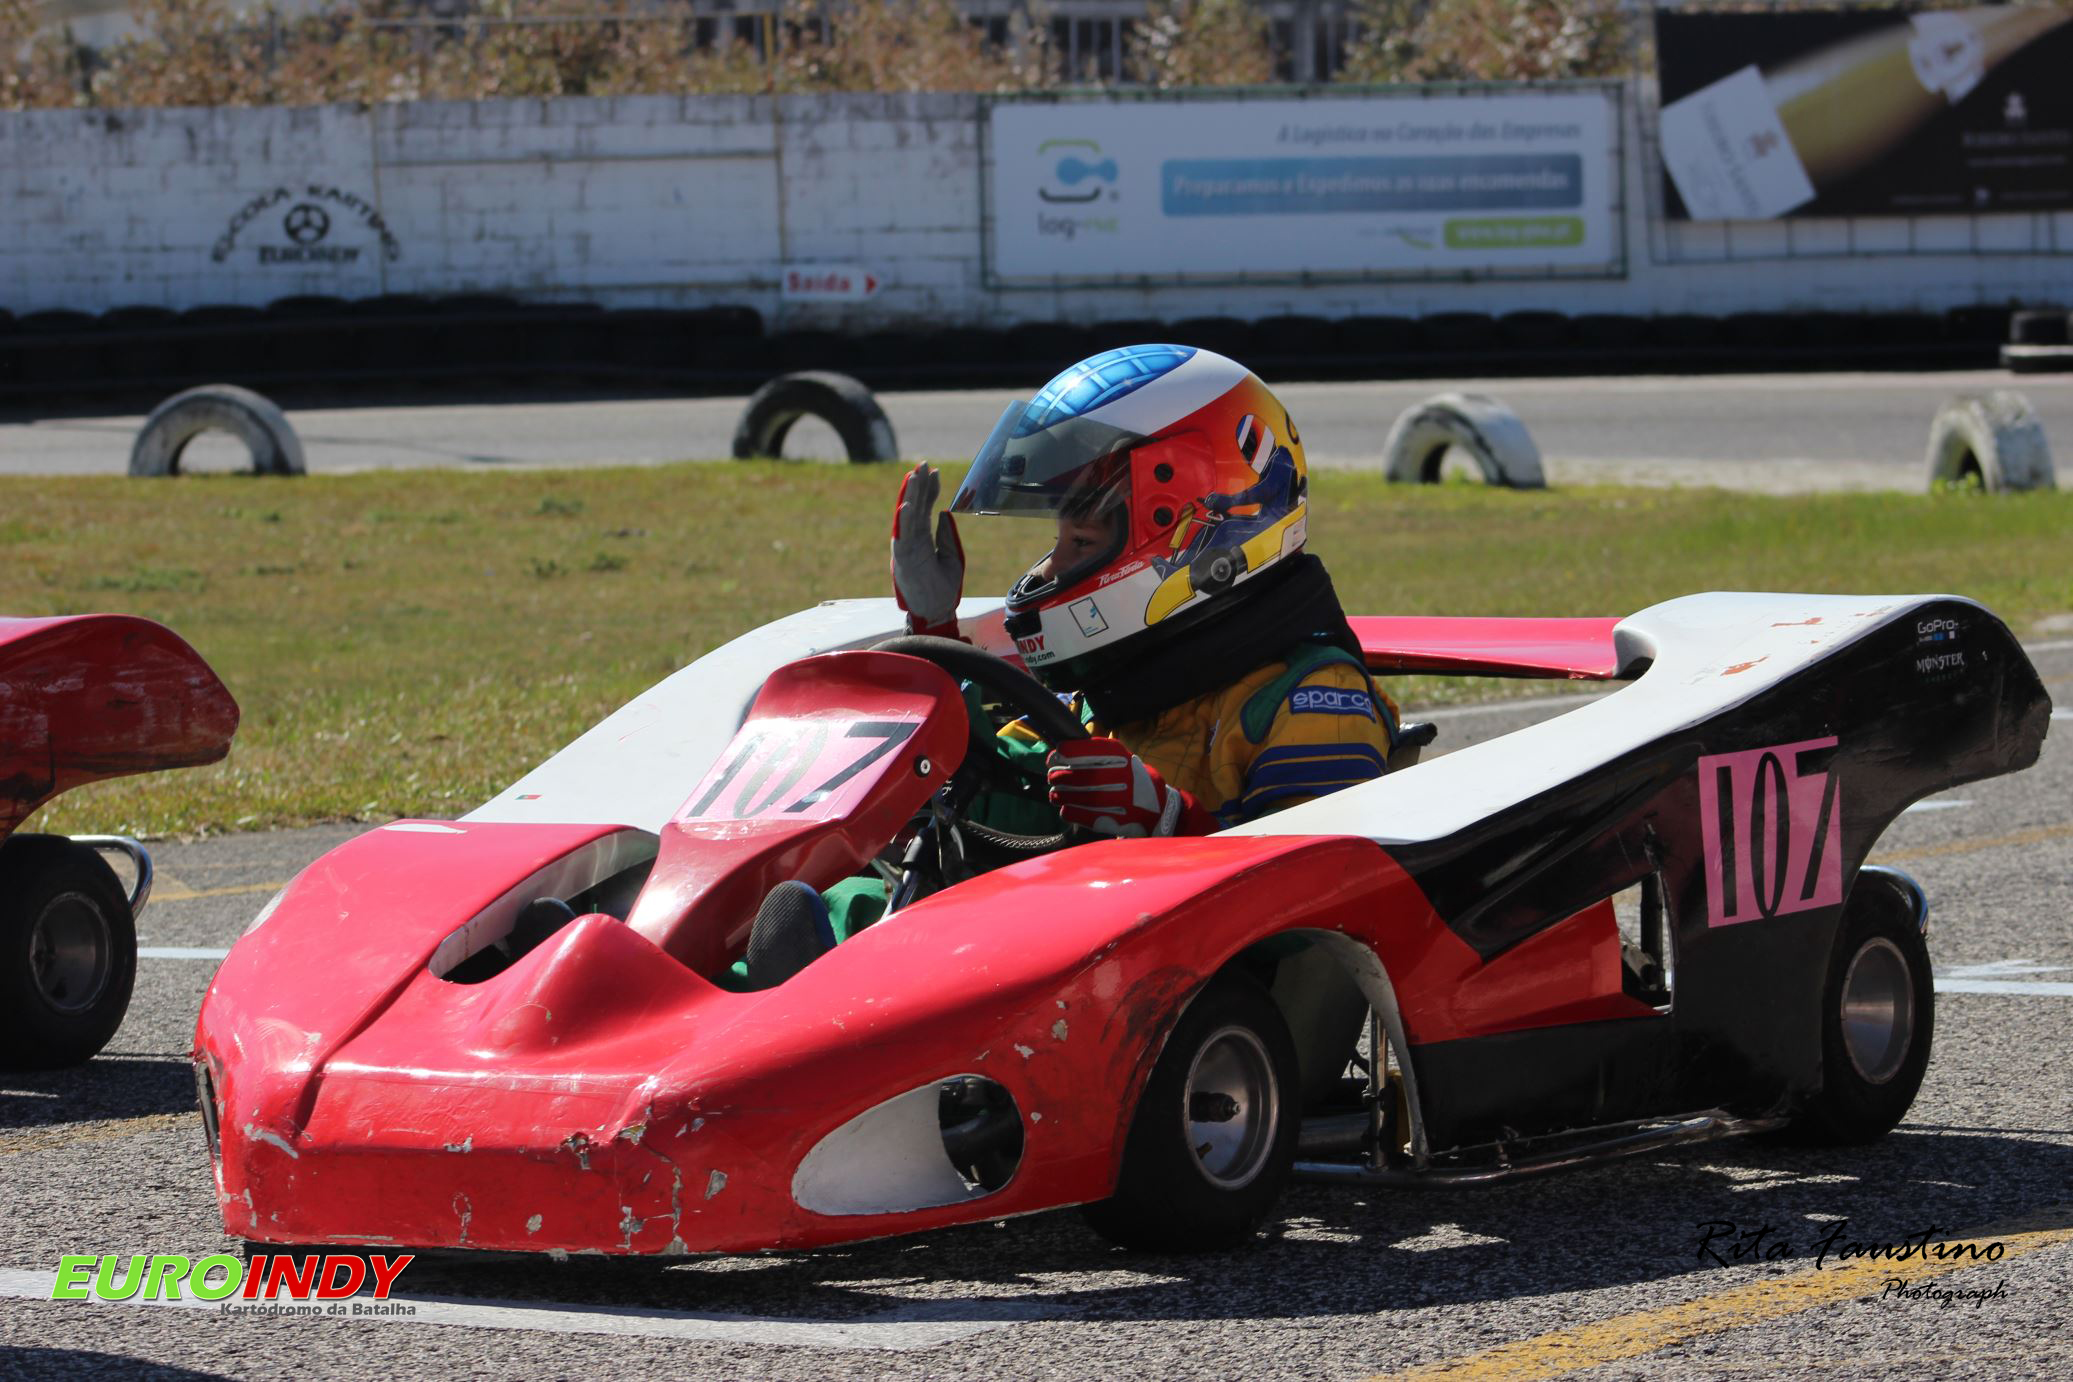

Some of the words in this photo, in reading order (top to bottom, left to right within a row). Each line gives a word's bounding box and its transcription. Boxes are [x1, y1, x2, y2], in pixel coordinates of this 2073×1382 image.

[1917, 619, 1956, 634] GoPro
[1916, 651, 1966, 673] MONSTER
[686, 719, 921, 819] 107
[1716, 745, 1840, 919] 107
